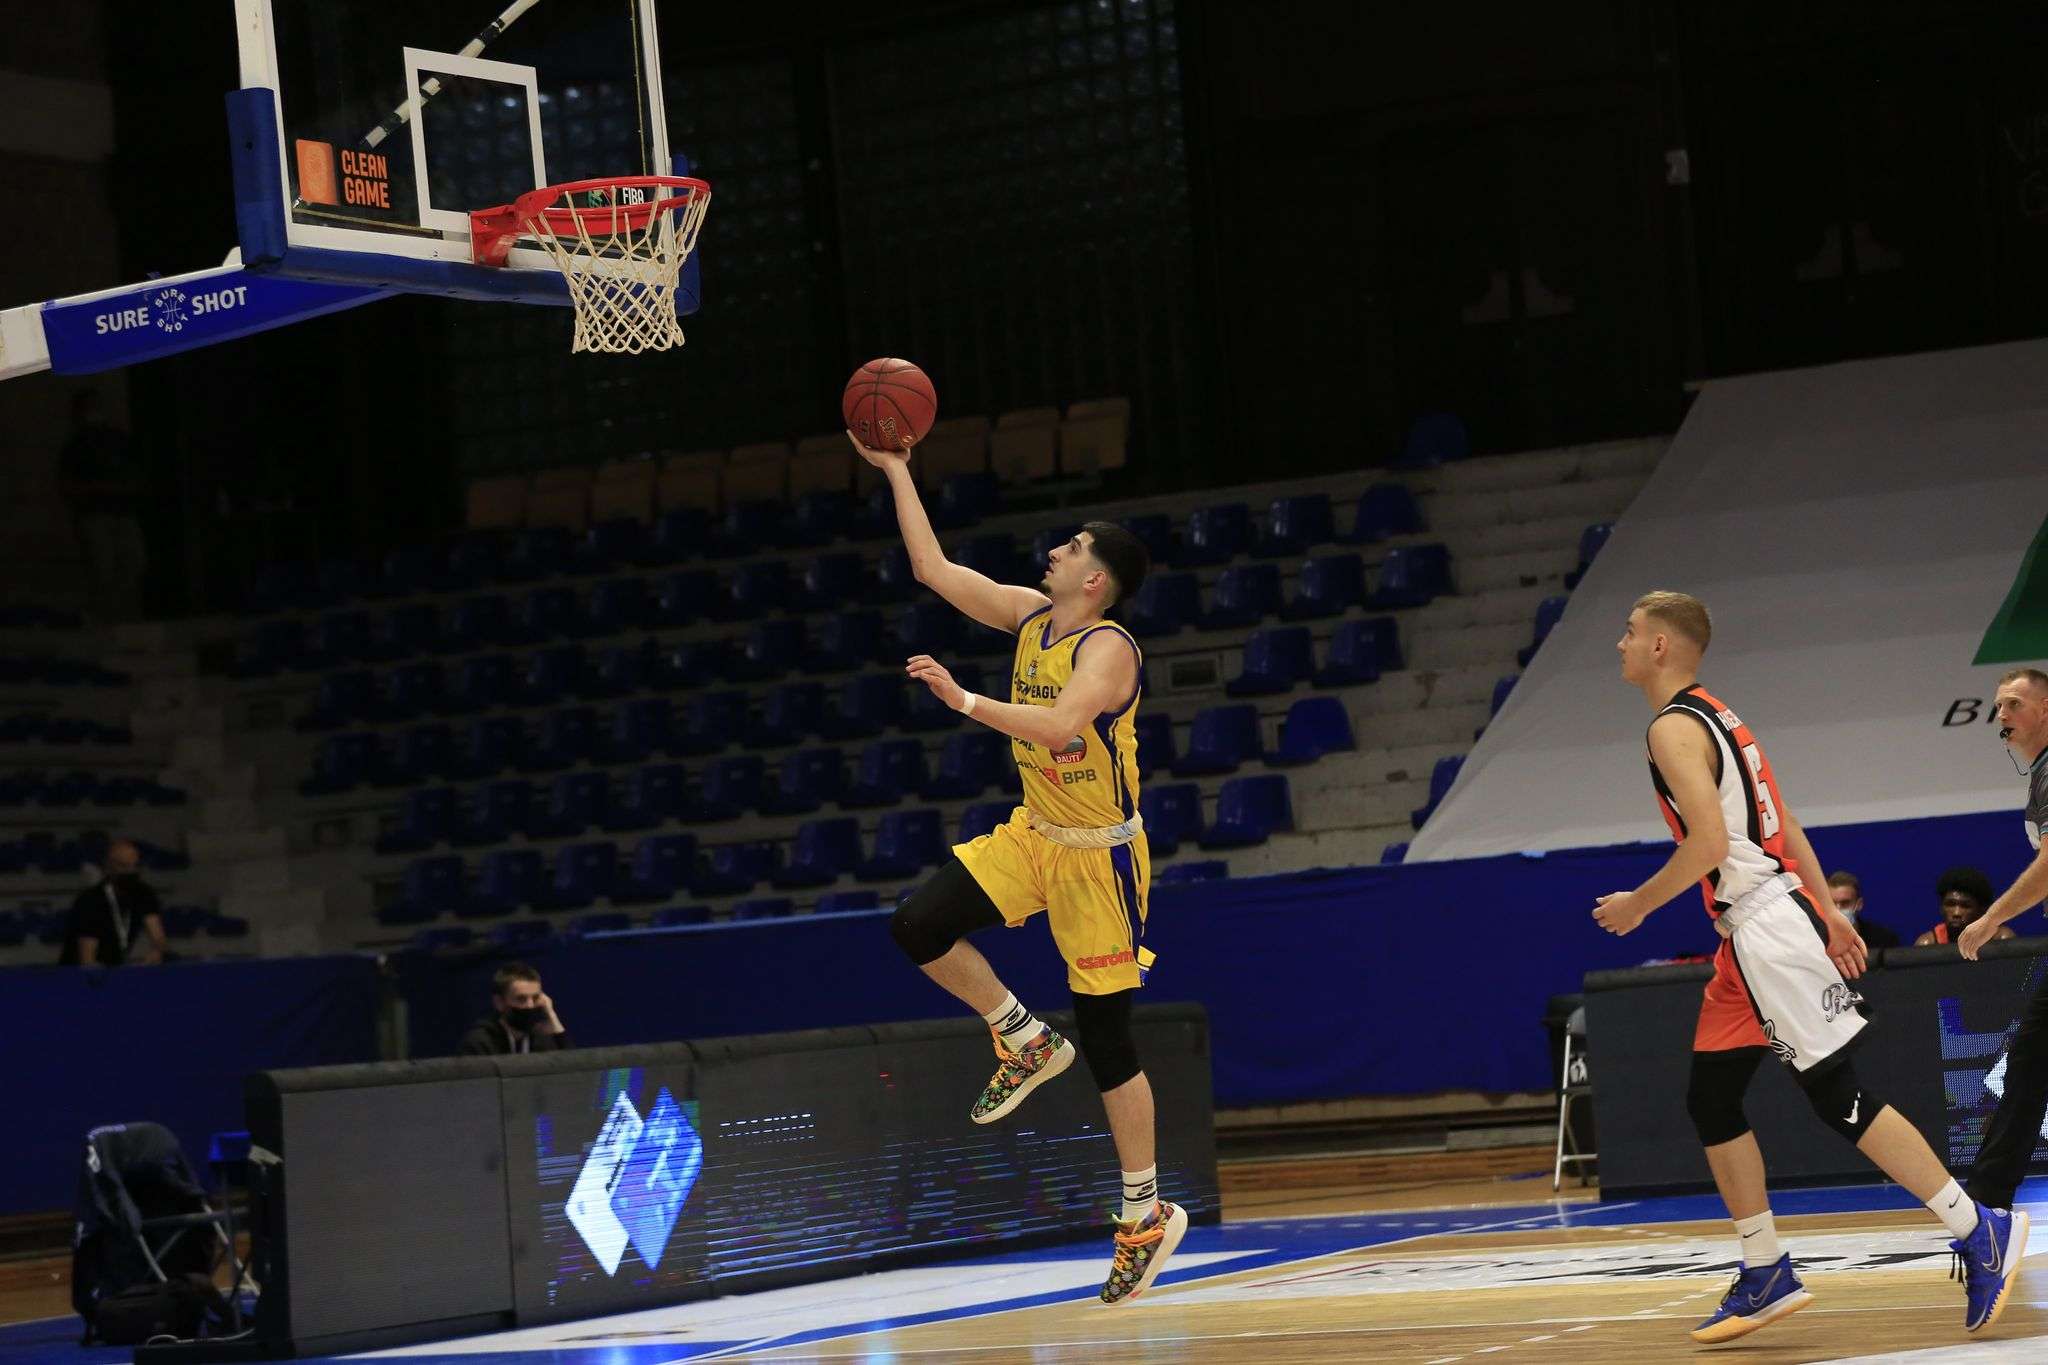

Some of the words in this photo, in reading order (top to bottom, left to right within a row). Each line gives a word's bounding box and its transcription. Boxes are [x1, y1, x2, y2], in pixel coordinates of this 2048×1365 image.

[341, 150, 387, 178] CLEAN
[344, 177, 391, 208] GAME
[622, 187, 644, 206] FIBA
[155, 289, 186, 307] SURE
[96, 307, 149, 334] SURE
[191, 286, 247, 316] SHOT
[157, 312, 188, 333] SHOT
[1062, 769, 1097, 785] BPB
